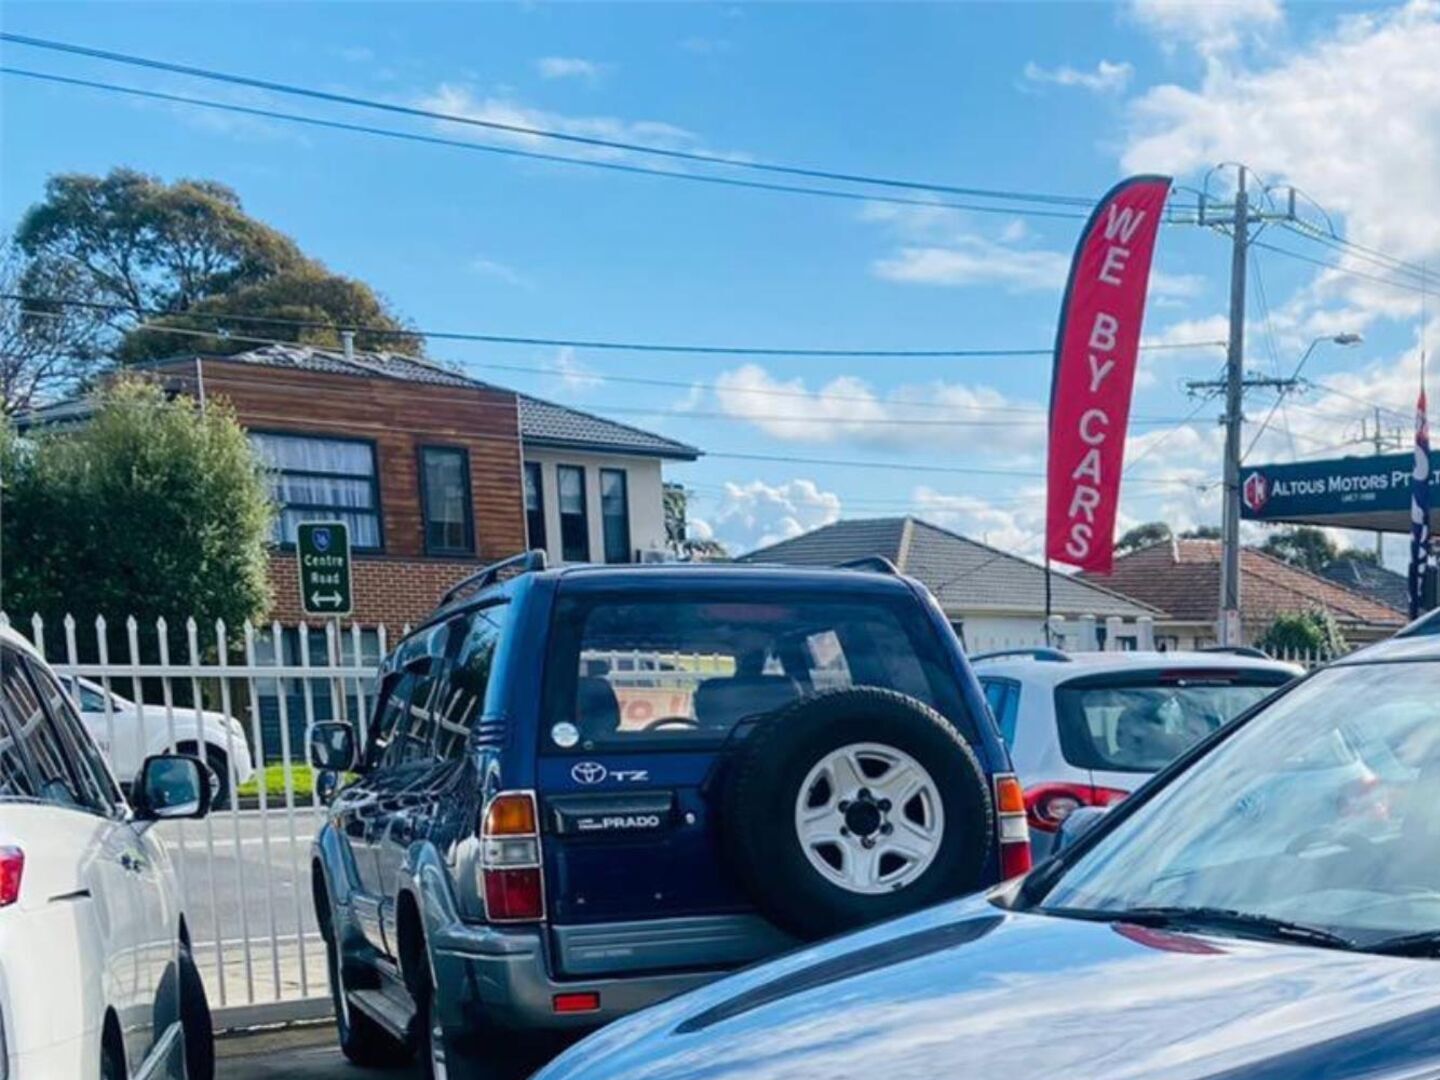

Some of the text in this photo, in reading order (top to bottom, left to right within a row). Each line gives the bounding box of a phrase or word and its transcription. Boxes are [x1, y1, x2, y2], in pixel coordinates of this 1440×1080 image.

[1065, 204, 1146, 558] WE BY CARS
[1271, 479, 1325, 498] ALTOUS
[1328, 473, 1388, 492] MOTORS
[1391, 470, 1412, 488] PT
[304, 554, 344, 567] Centre
[311, 571, 340, 584] Road
[609, 770, 649, 781] TZ
[602, 815, 660, 829] PRADO
